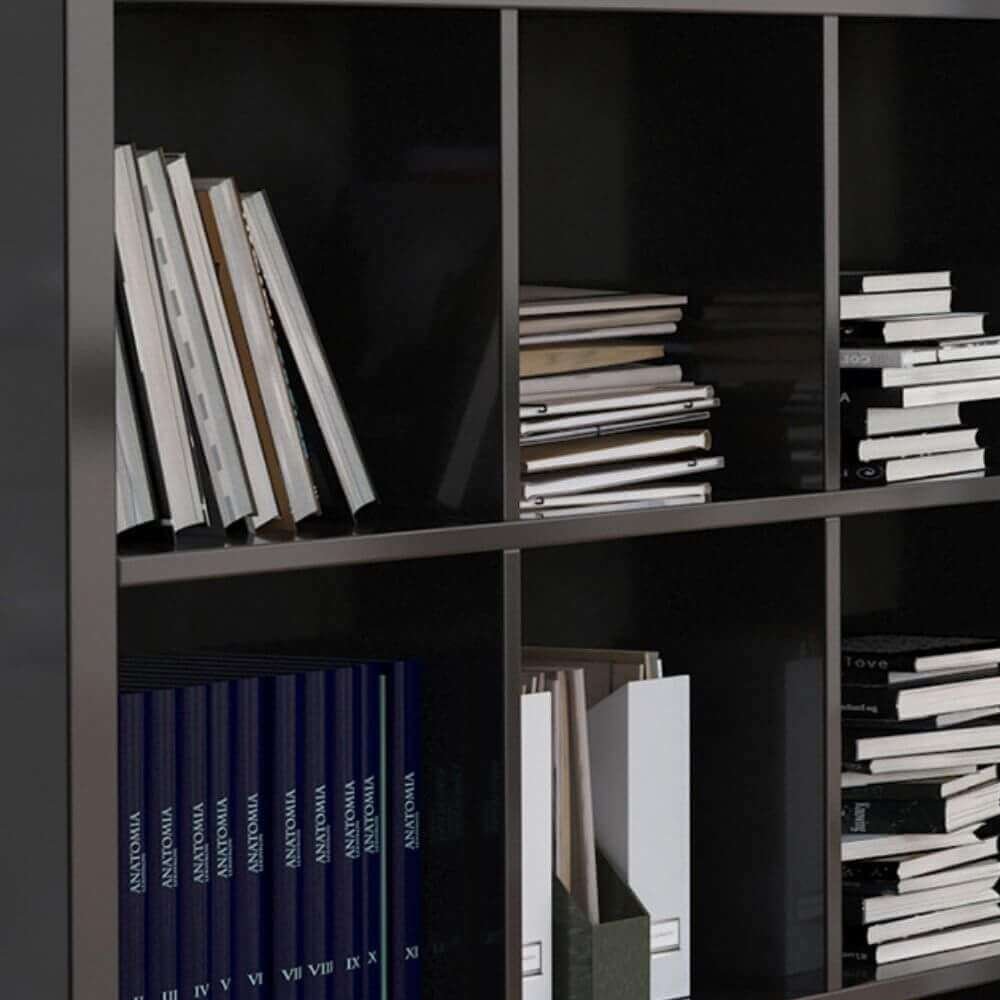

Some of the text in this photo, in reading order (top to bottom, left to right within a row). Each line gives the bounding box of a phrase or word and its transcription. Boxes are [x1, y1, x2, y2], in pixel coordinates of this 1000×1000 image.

[161, 806, 173, 889] ANATOMIA
[192, 801, 204, 884] ANATOMIA
[216, 796, 228, 879] ANATOMIA
[247, 792, 259, 873] ANATOMIA
[284, 788, 296, 868] ANATOMIA
[314, 784, 326, 864] ANATOMIA
[344, 779, 356, 859] ANATOMIA
[363, 775, 375, 854] ANATOMIA
[403, 770, 415, 850] ANATOMIA
[129, 811, 141, 893] ANATOMIA
[194, 983, 210, 999] IV
[219, 977, 231, 991] V
[248, 972, 264, 987] VI
[281, 966, 303, 982] VII
[308, 961, 334, 977] VIII
[346, 955, 361, 971] IX
[367, 950, 378, 965] X
[404, 945, 419, 961] XI
